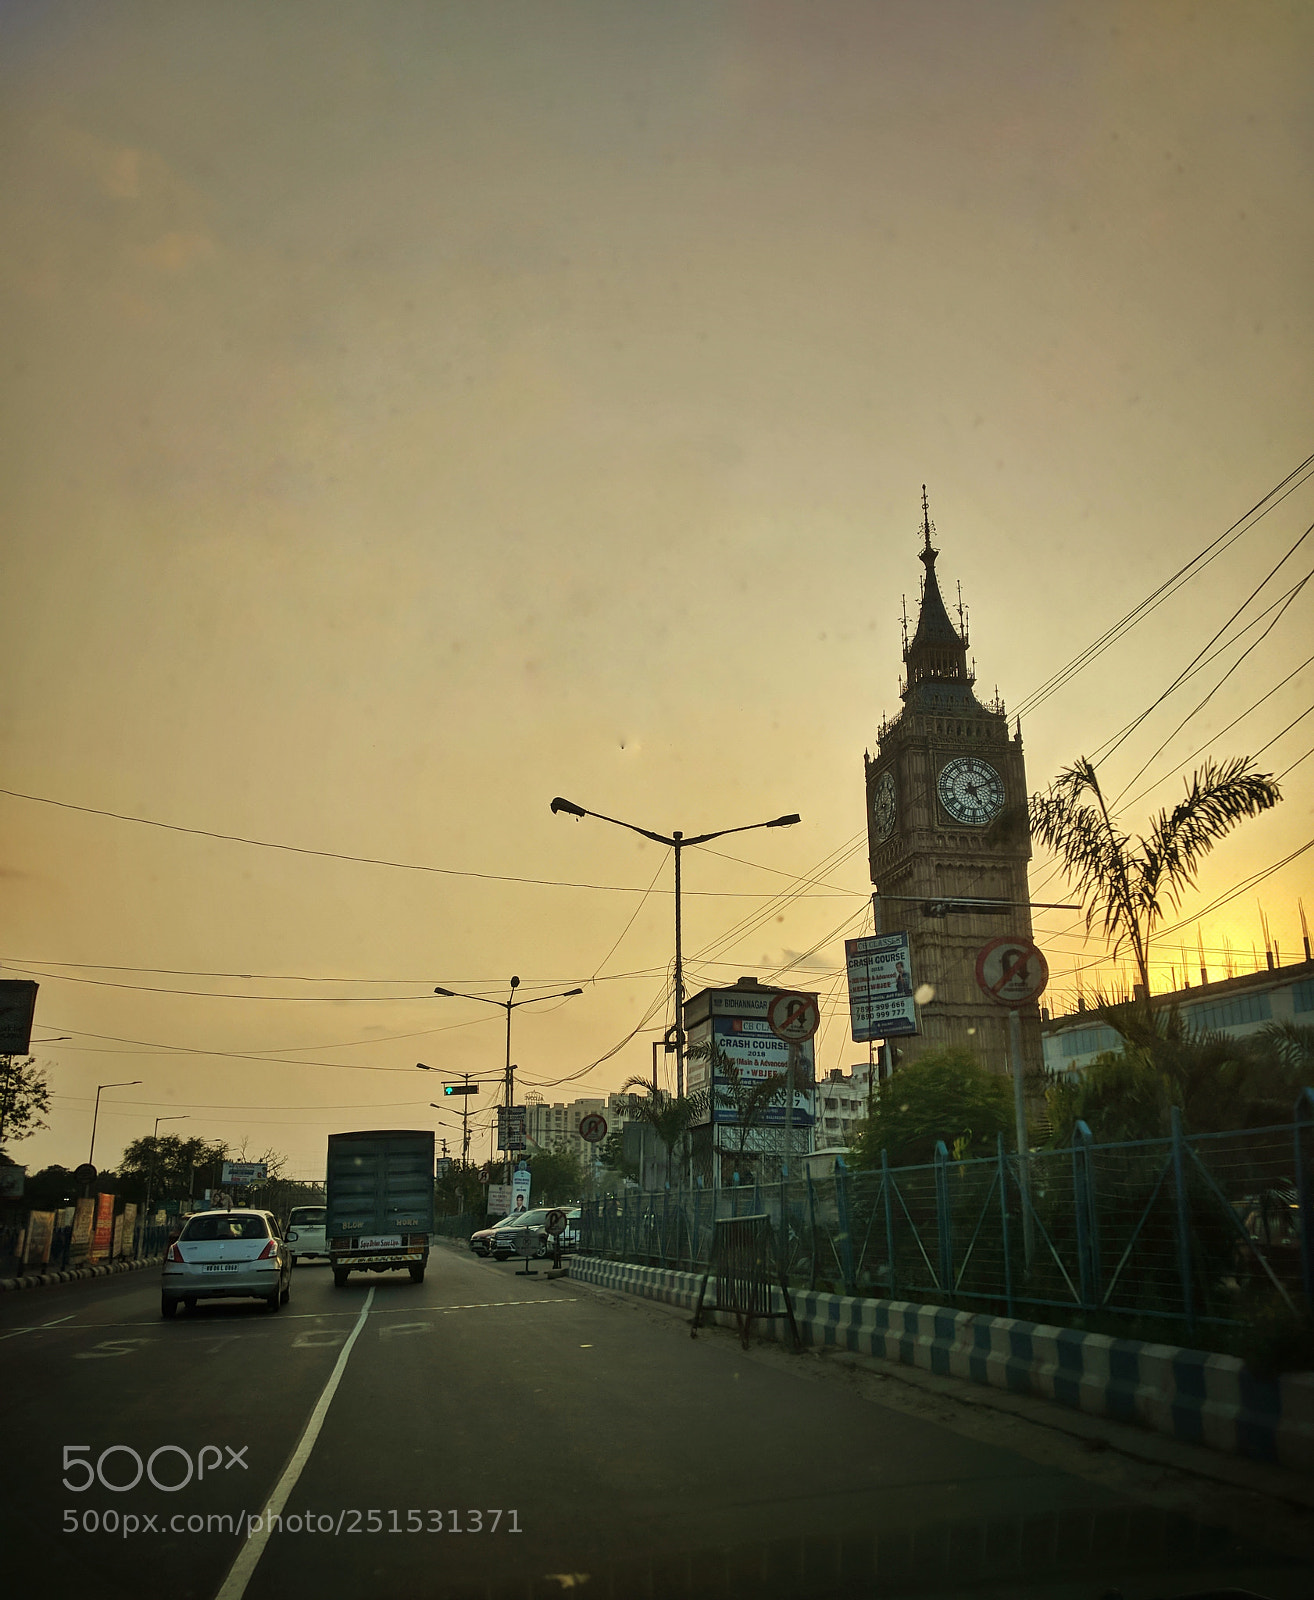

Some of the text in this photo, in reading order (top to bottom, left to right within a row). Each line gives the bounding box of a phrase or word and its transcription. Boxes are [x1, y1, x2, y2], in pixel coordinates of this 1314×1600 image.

[849, 952, 905, 968] CRASH COURSE
[725, 999, 767, 1009] BIDHANNAGAR
[876, 1003, 889, 1011] 999
[743, 1022, 754, 1030] CB
[720, 1039, 789, 1050] CRASH COURSE
